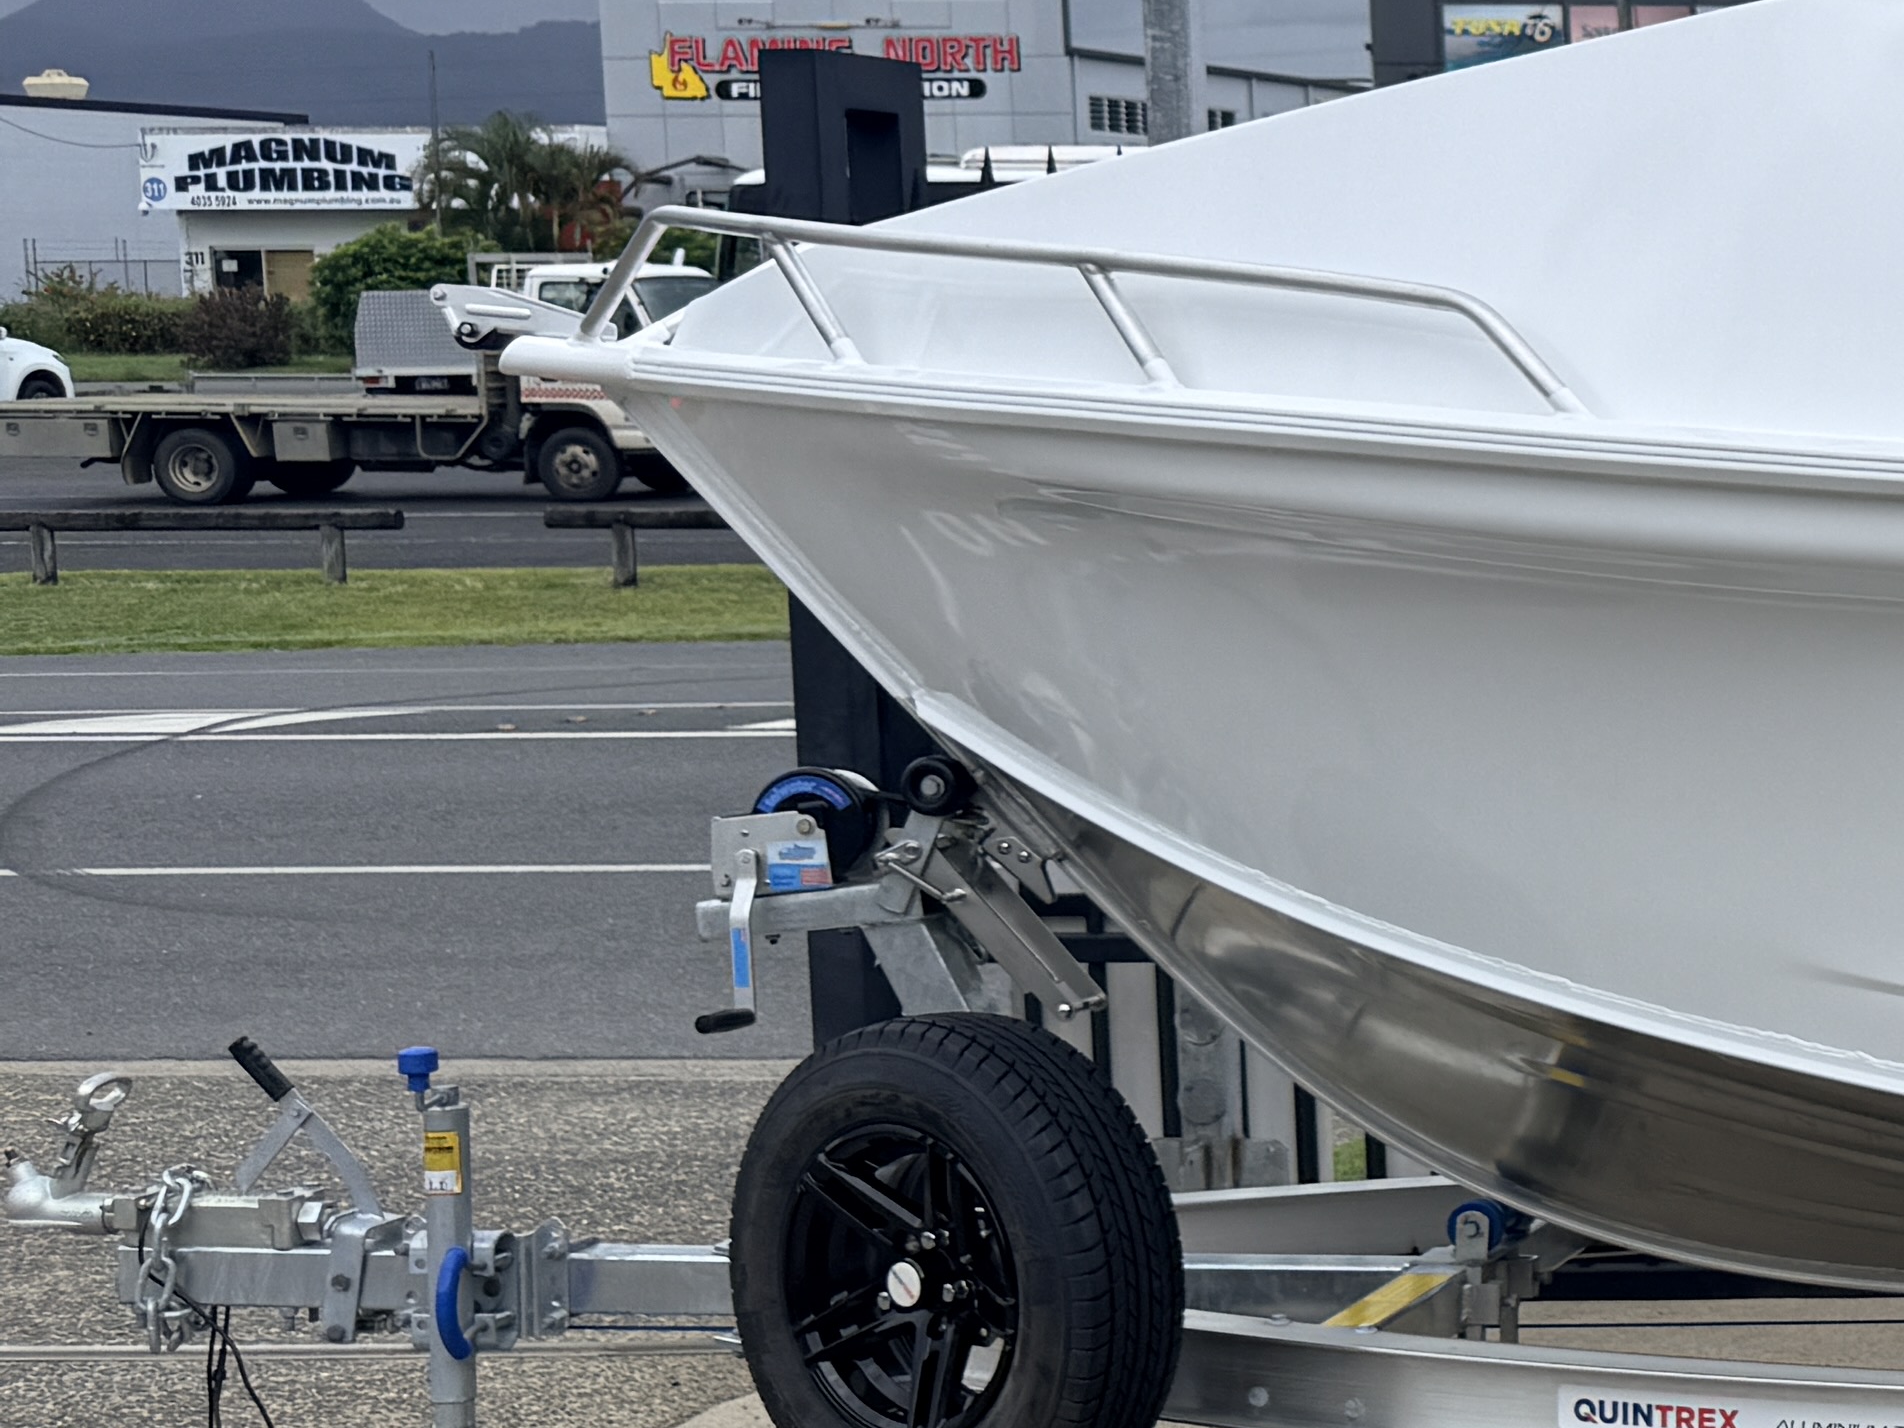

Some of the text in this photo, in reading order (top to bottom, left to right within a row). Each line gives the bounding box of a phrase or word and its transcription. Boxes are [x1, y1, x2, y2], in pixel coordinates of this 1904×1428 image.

[883, 34, 1021, 72] NORTH
[187, 136, 398, 172] MAGNUM
[144, 181, 167, 198] 311
[174, 167, 414, 193] PLUMBING
[184, 251, 205, 267] 311
